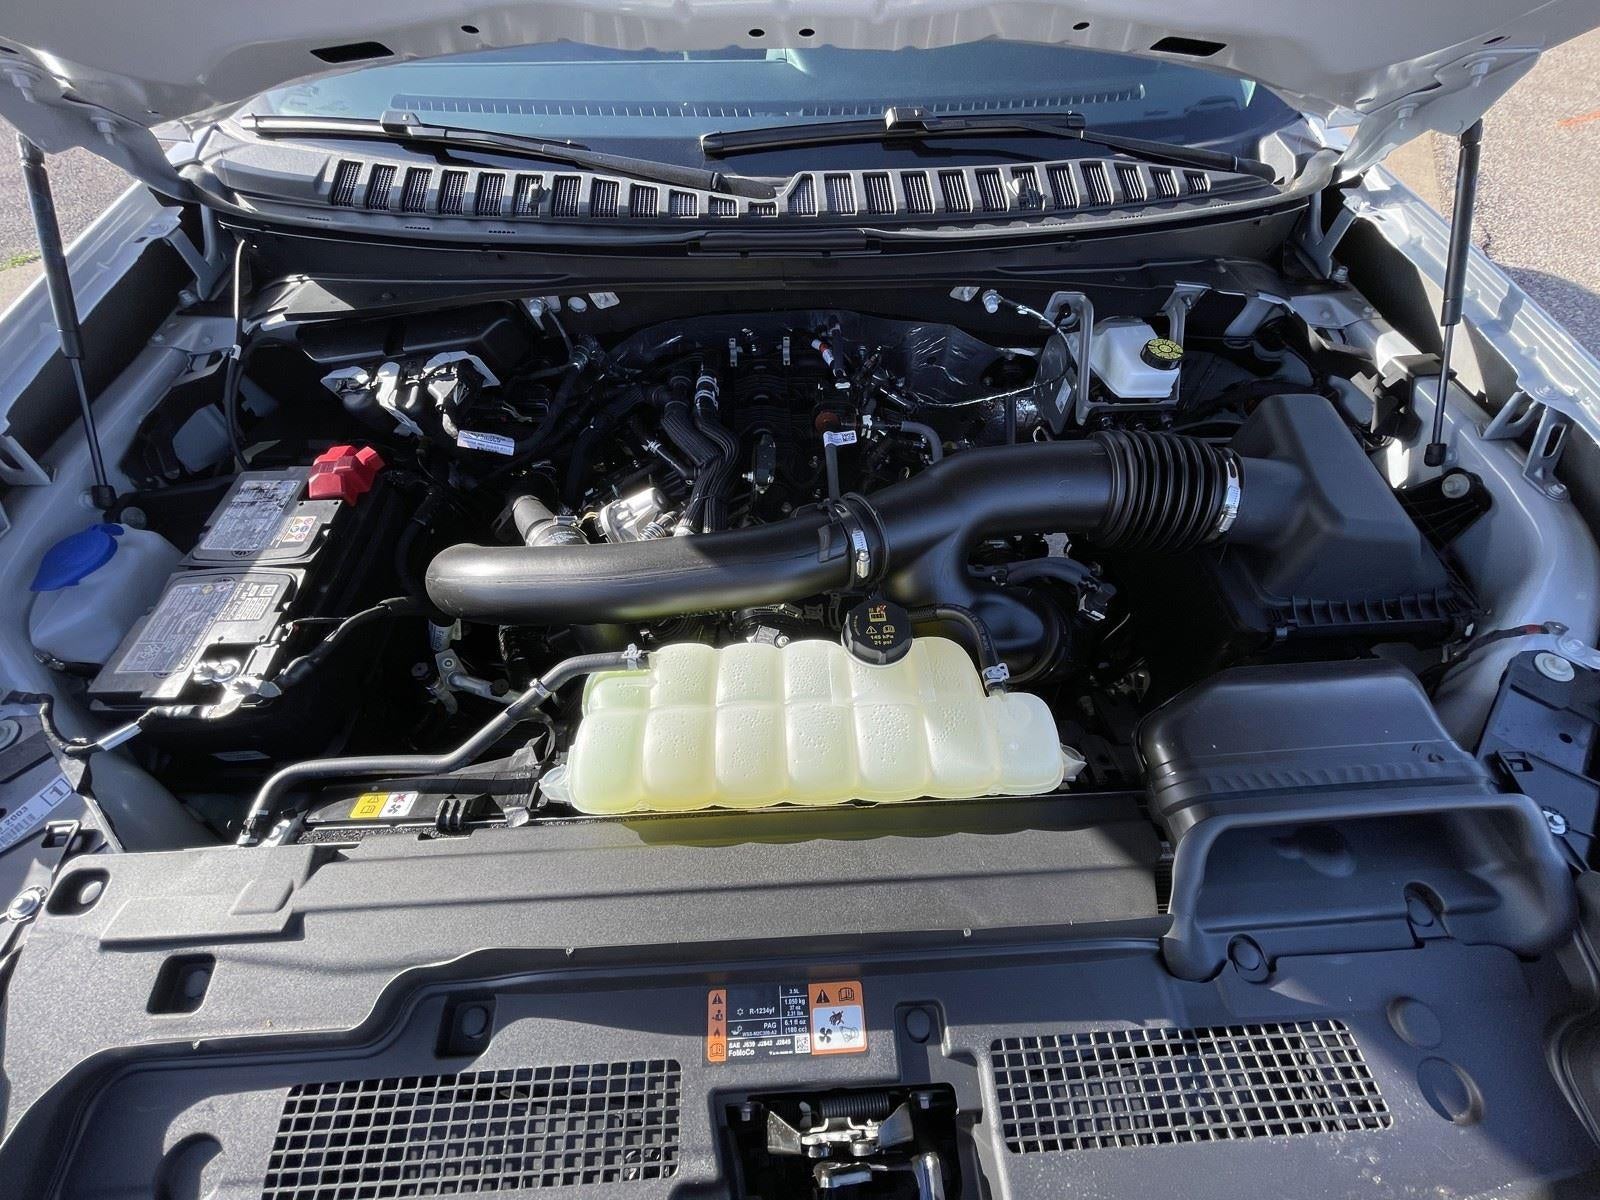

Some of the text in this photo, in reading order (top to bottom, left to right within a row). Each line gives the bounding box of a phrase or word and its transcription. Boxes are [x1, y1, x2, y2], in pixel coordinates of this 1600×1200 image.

[798, 998, 805, 1006] kg
[749, 1007, 775, 1015] R-1234yf
[728, 1048, 755, 1057] FoMoCo
